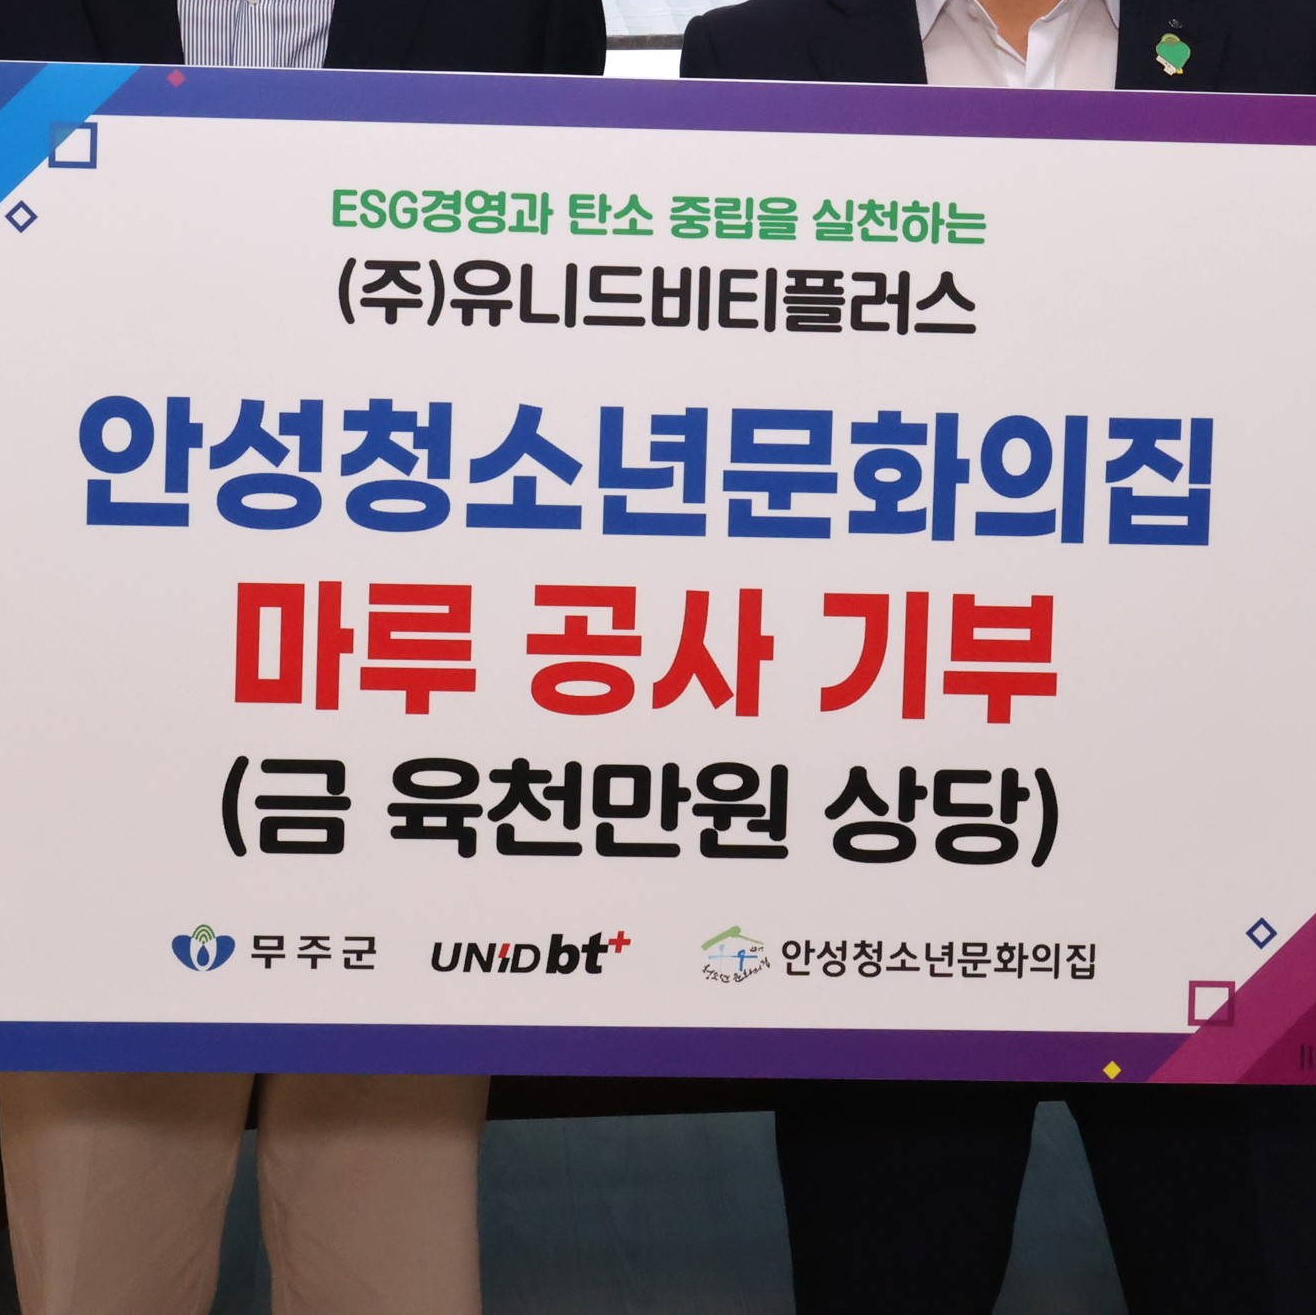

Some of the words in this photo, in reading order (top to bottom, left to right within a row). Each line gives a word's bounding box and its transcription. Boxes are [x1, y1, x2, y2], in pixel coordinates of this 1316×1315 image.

[332, 188, 555, 236] ESG경영과
[568, 193, 654, 237] 탄소
[669, 195, 799, 241] 중립을
[812, 198, 987, 245] 실천하는
[338, 257, 977, 336] (주)유니드비티플러스
[78, 395, 1214, 547] 안성청소년문화의집
[234, 580, 477, 716] 마루
[525, 584, 775, 718] 공사
[819, 590, 1058, 725] 기부
[221, 755, 352, 858] (금
[386, 757, 789, 860] 육천만원
[823, 765, 1059, 868] 상당)
[250, 934, 377, 970] 무주군
[781, 939, 1096, 980] 안성청소년문화의집
